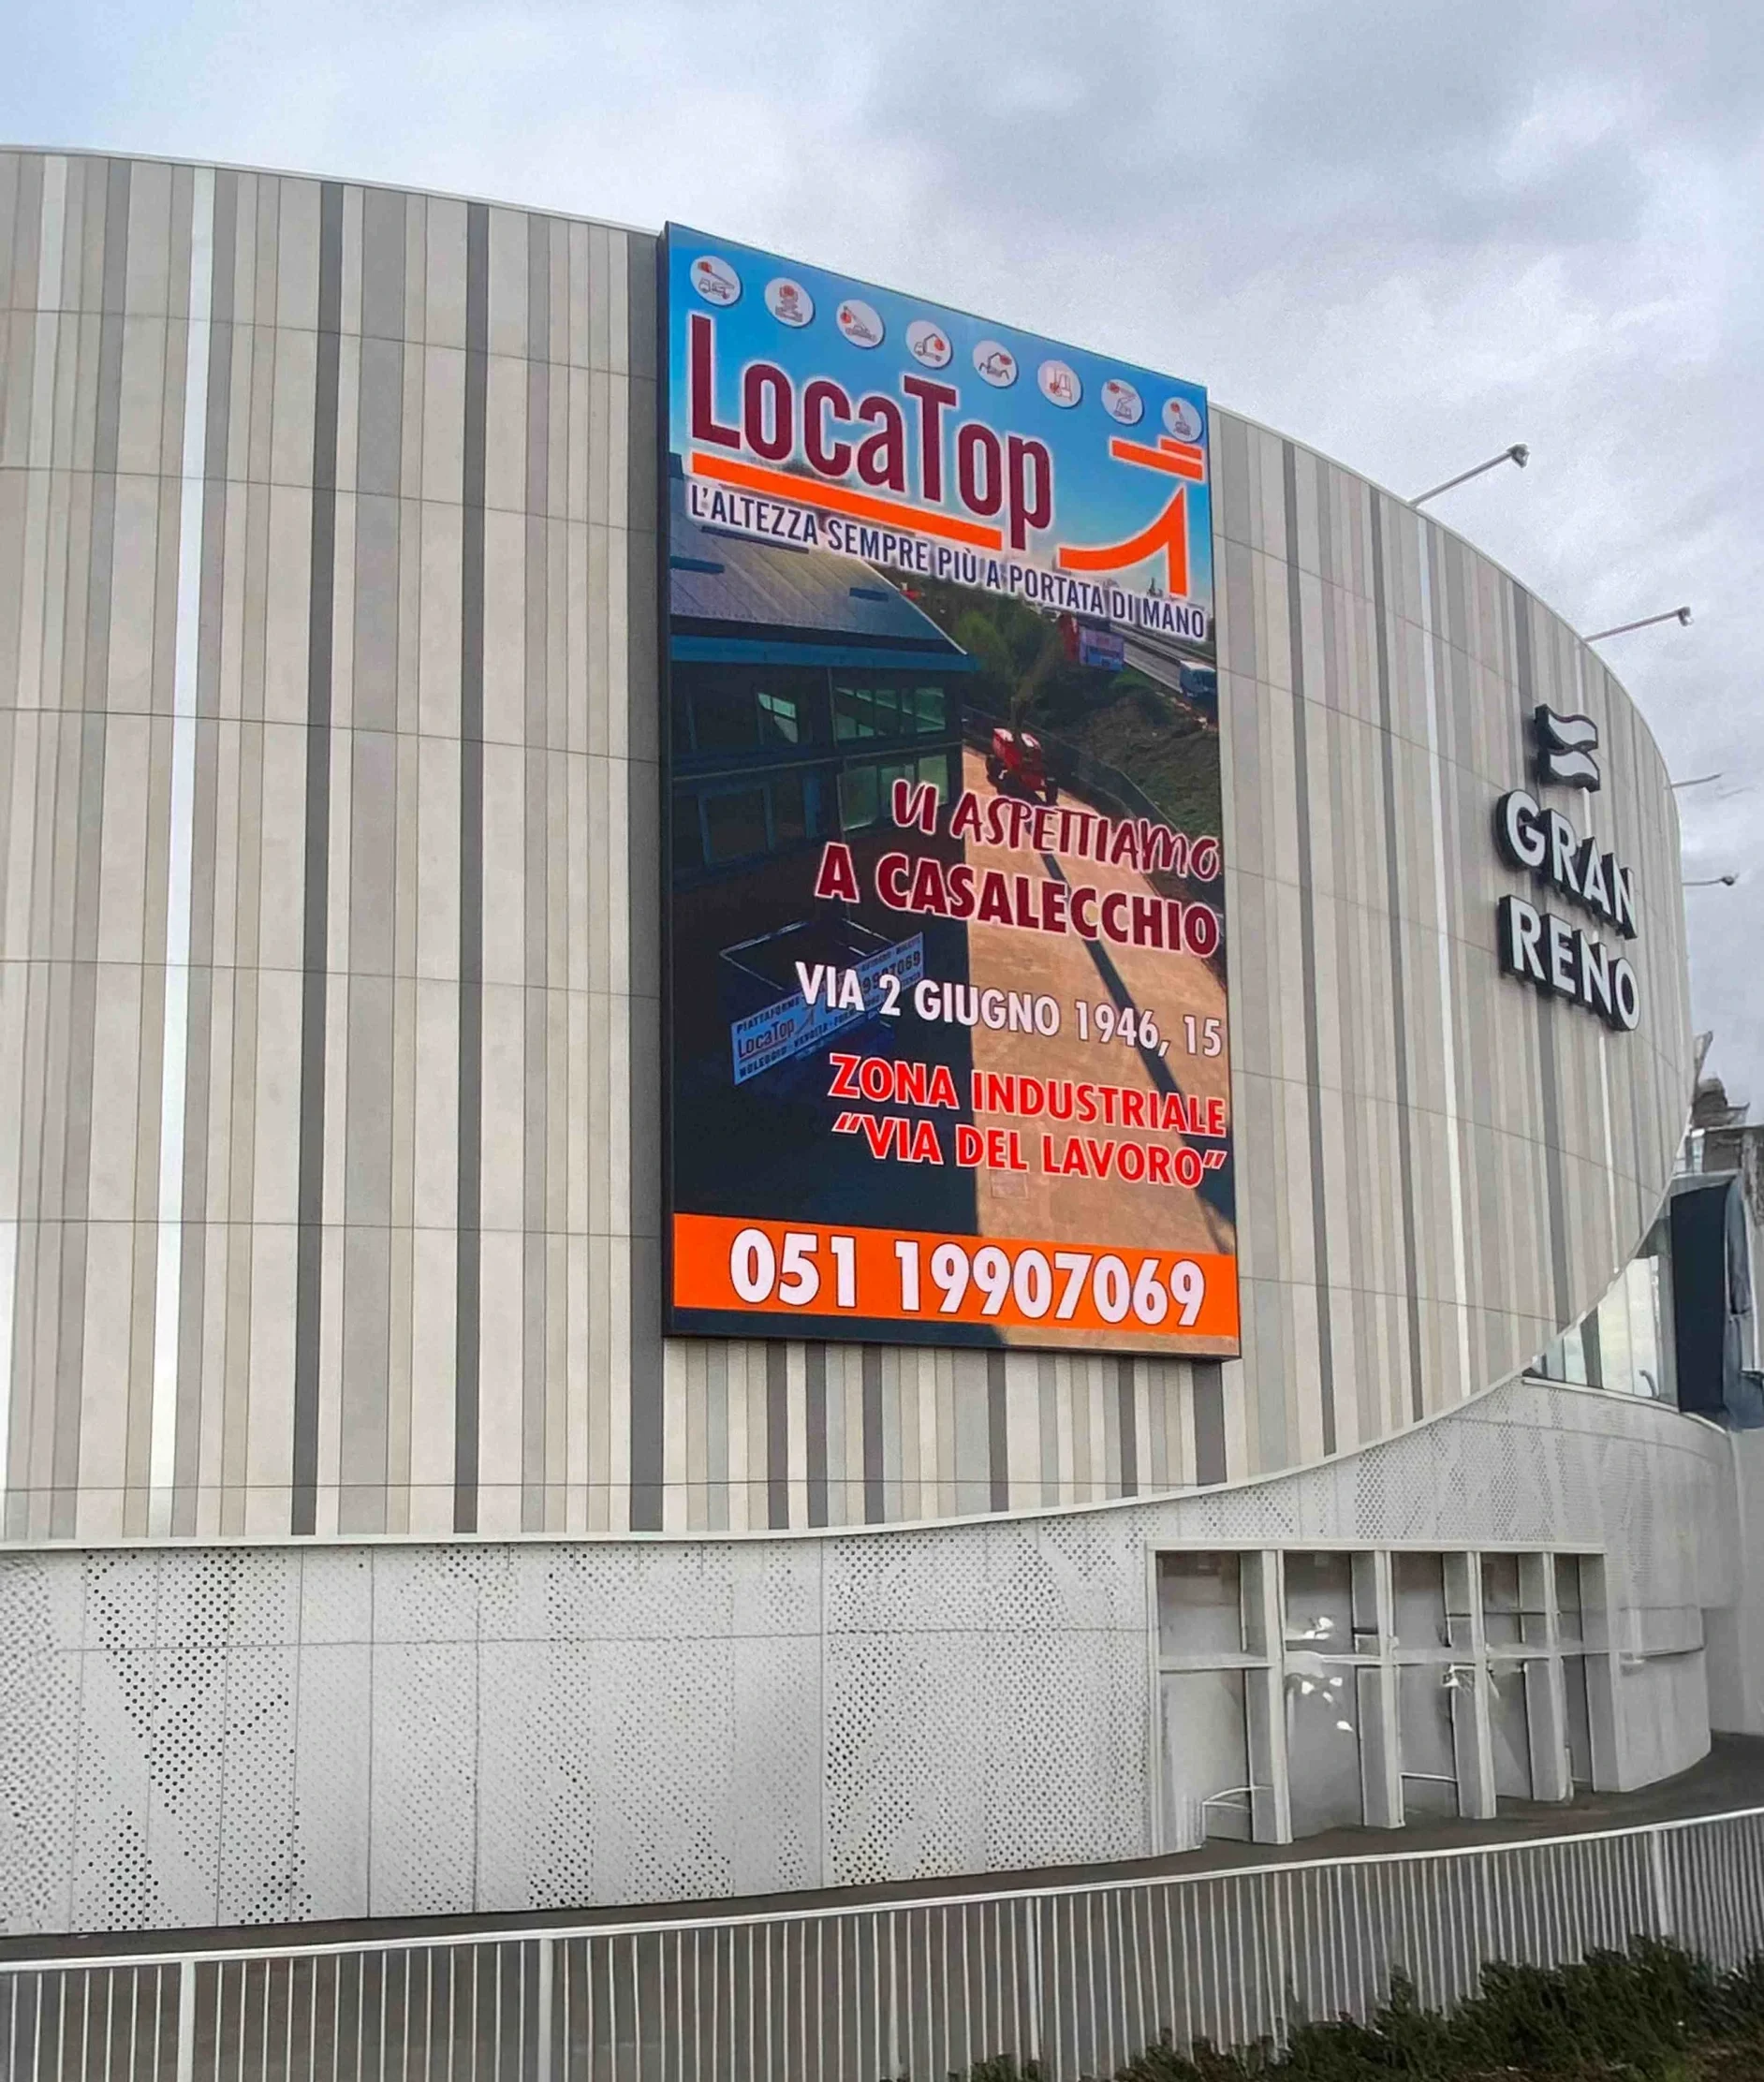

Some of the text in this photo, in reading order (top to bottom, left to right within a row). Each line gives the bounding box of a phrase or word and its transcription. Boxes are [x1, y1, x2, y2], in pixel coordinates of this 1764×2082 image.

[692, 314, 1051, 550] LocaTop
[691, 484, 1204, 638] L'ALTEZZA SEMPRE PIÙ A PORTATA DI MANO
[894, 780, 1220, 881] VI ASPETTIAMO
[1502, 789, 1639, 939] GRAN
[816, 844, 1219, 958] A CASALECCHIO
[795, 961, 866, 1012] VIA
[879, 975, 901, 1016] 2
[915, 979, 1060, 1036] GIUGNO
[1076, 1000, 1169, 1057] 1946,
[1184, 1016, 1222, 1057] 15
[1500, 894, 1641, 1031] RENO
[738, 1019, 795, 1059] LocaTop
[829, 1053, 1227, 1137] ZONA INDUSTRIALE
[956, 1126, 1028, 1172] DEL
[730, 1228, 1206, 1327] 051 19907069
